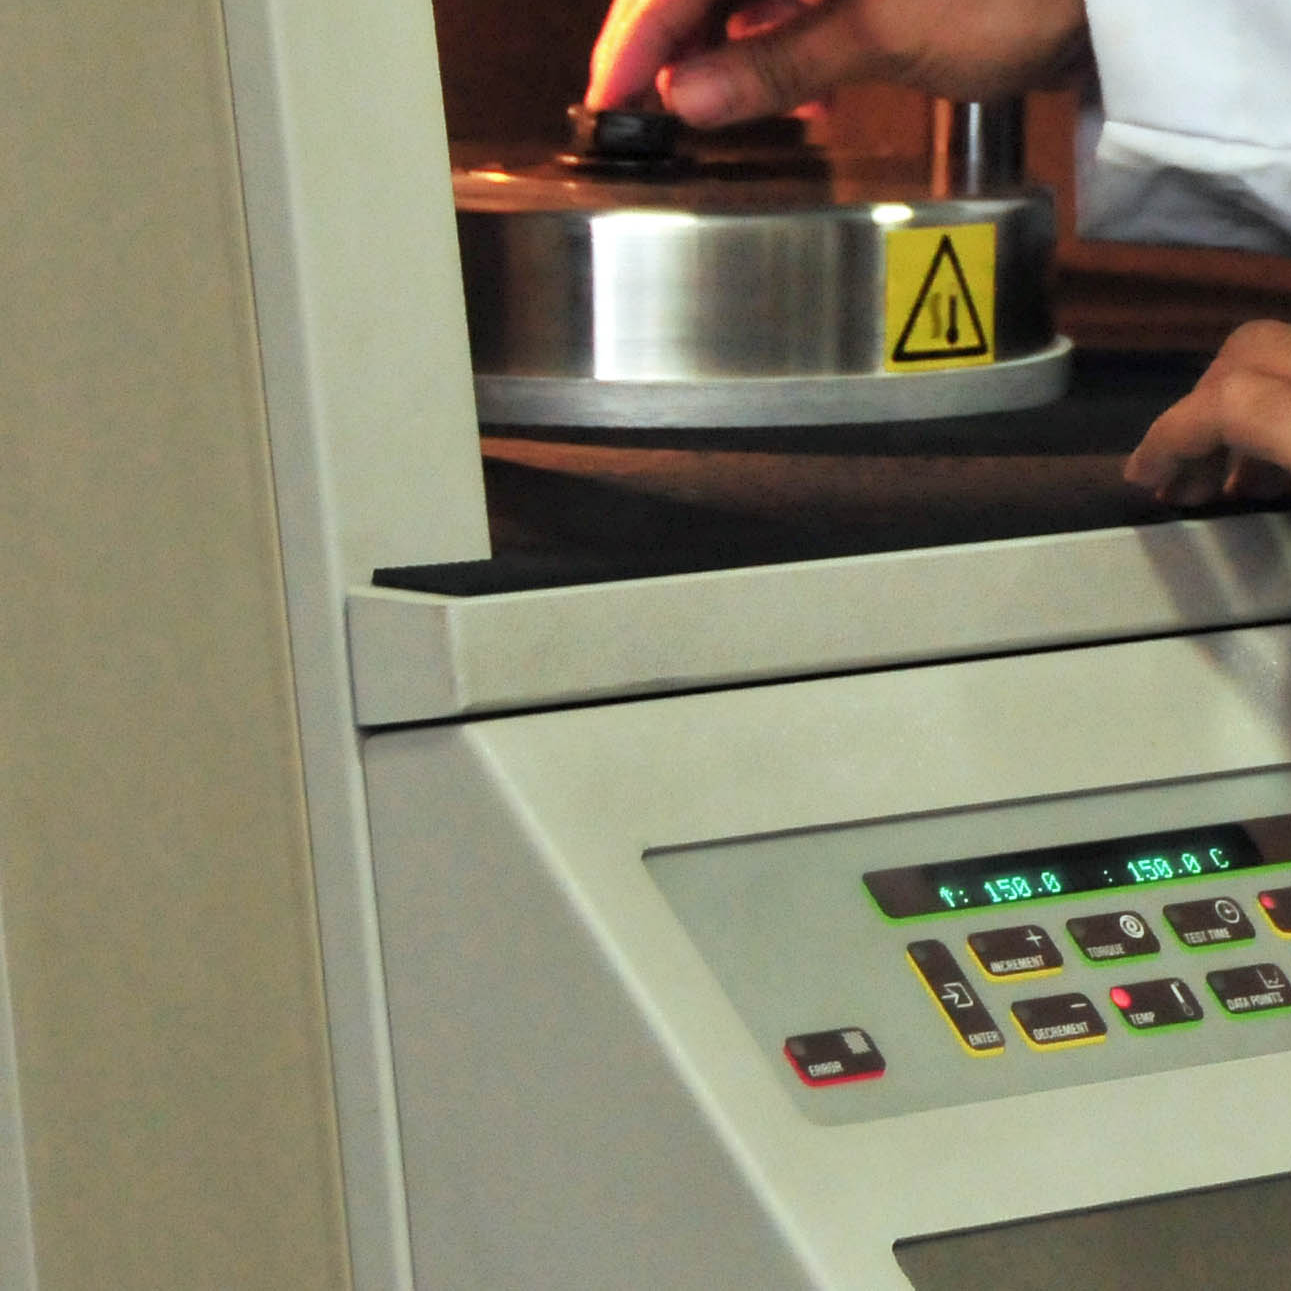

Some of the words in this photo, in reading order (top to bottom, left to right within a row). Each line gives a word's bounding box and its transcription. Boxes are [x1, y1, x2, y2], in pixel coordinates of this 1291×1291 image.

[984, 871, 1061, 903] 150.0
[1127, 852, 1201, 882] 150.0
[990, 954, 1045, 973] INCREMENT
[1226, 996, 1250, 1011] DATA
[1129, 1011, 1156, 1026] TEMP
[968, 1030, 1000, 1046] ENTER
[1032, 1021, 1090, 1041] DECREMENT
